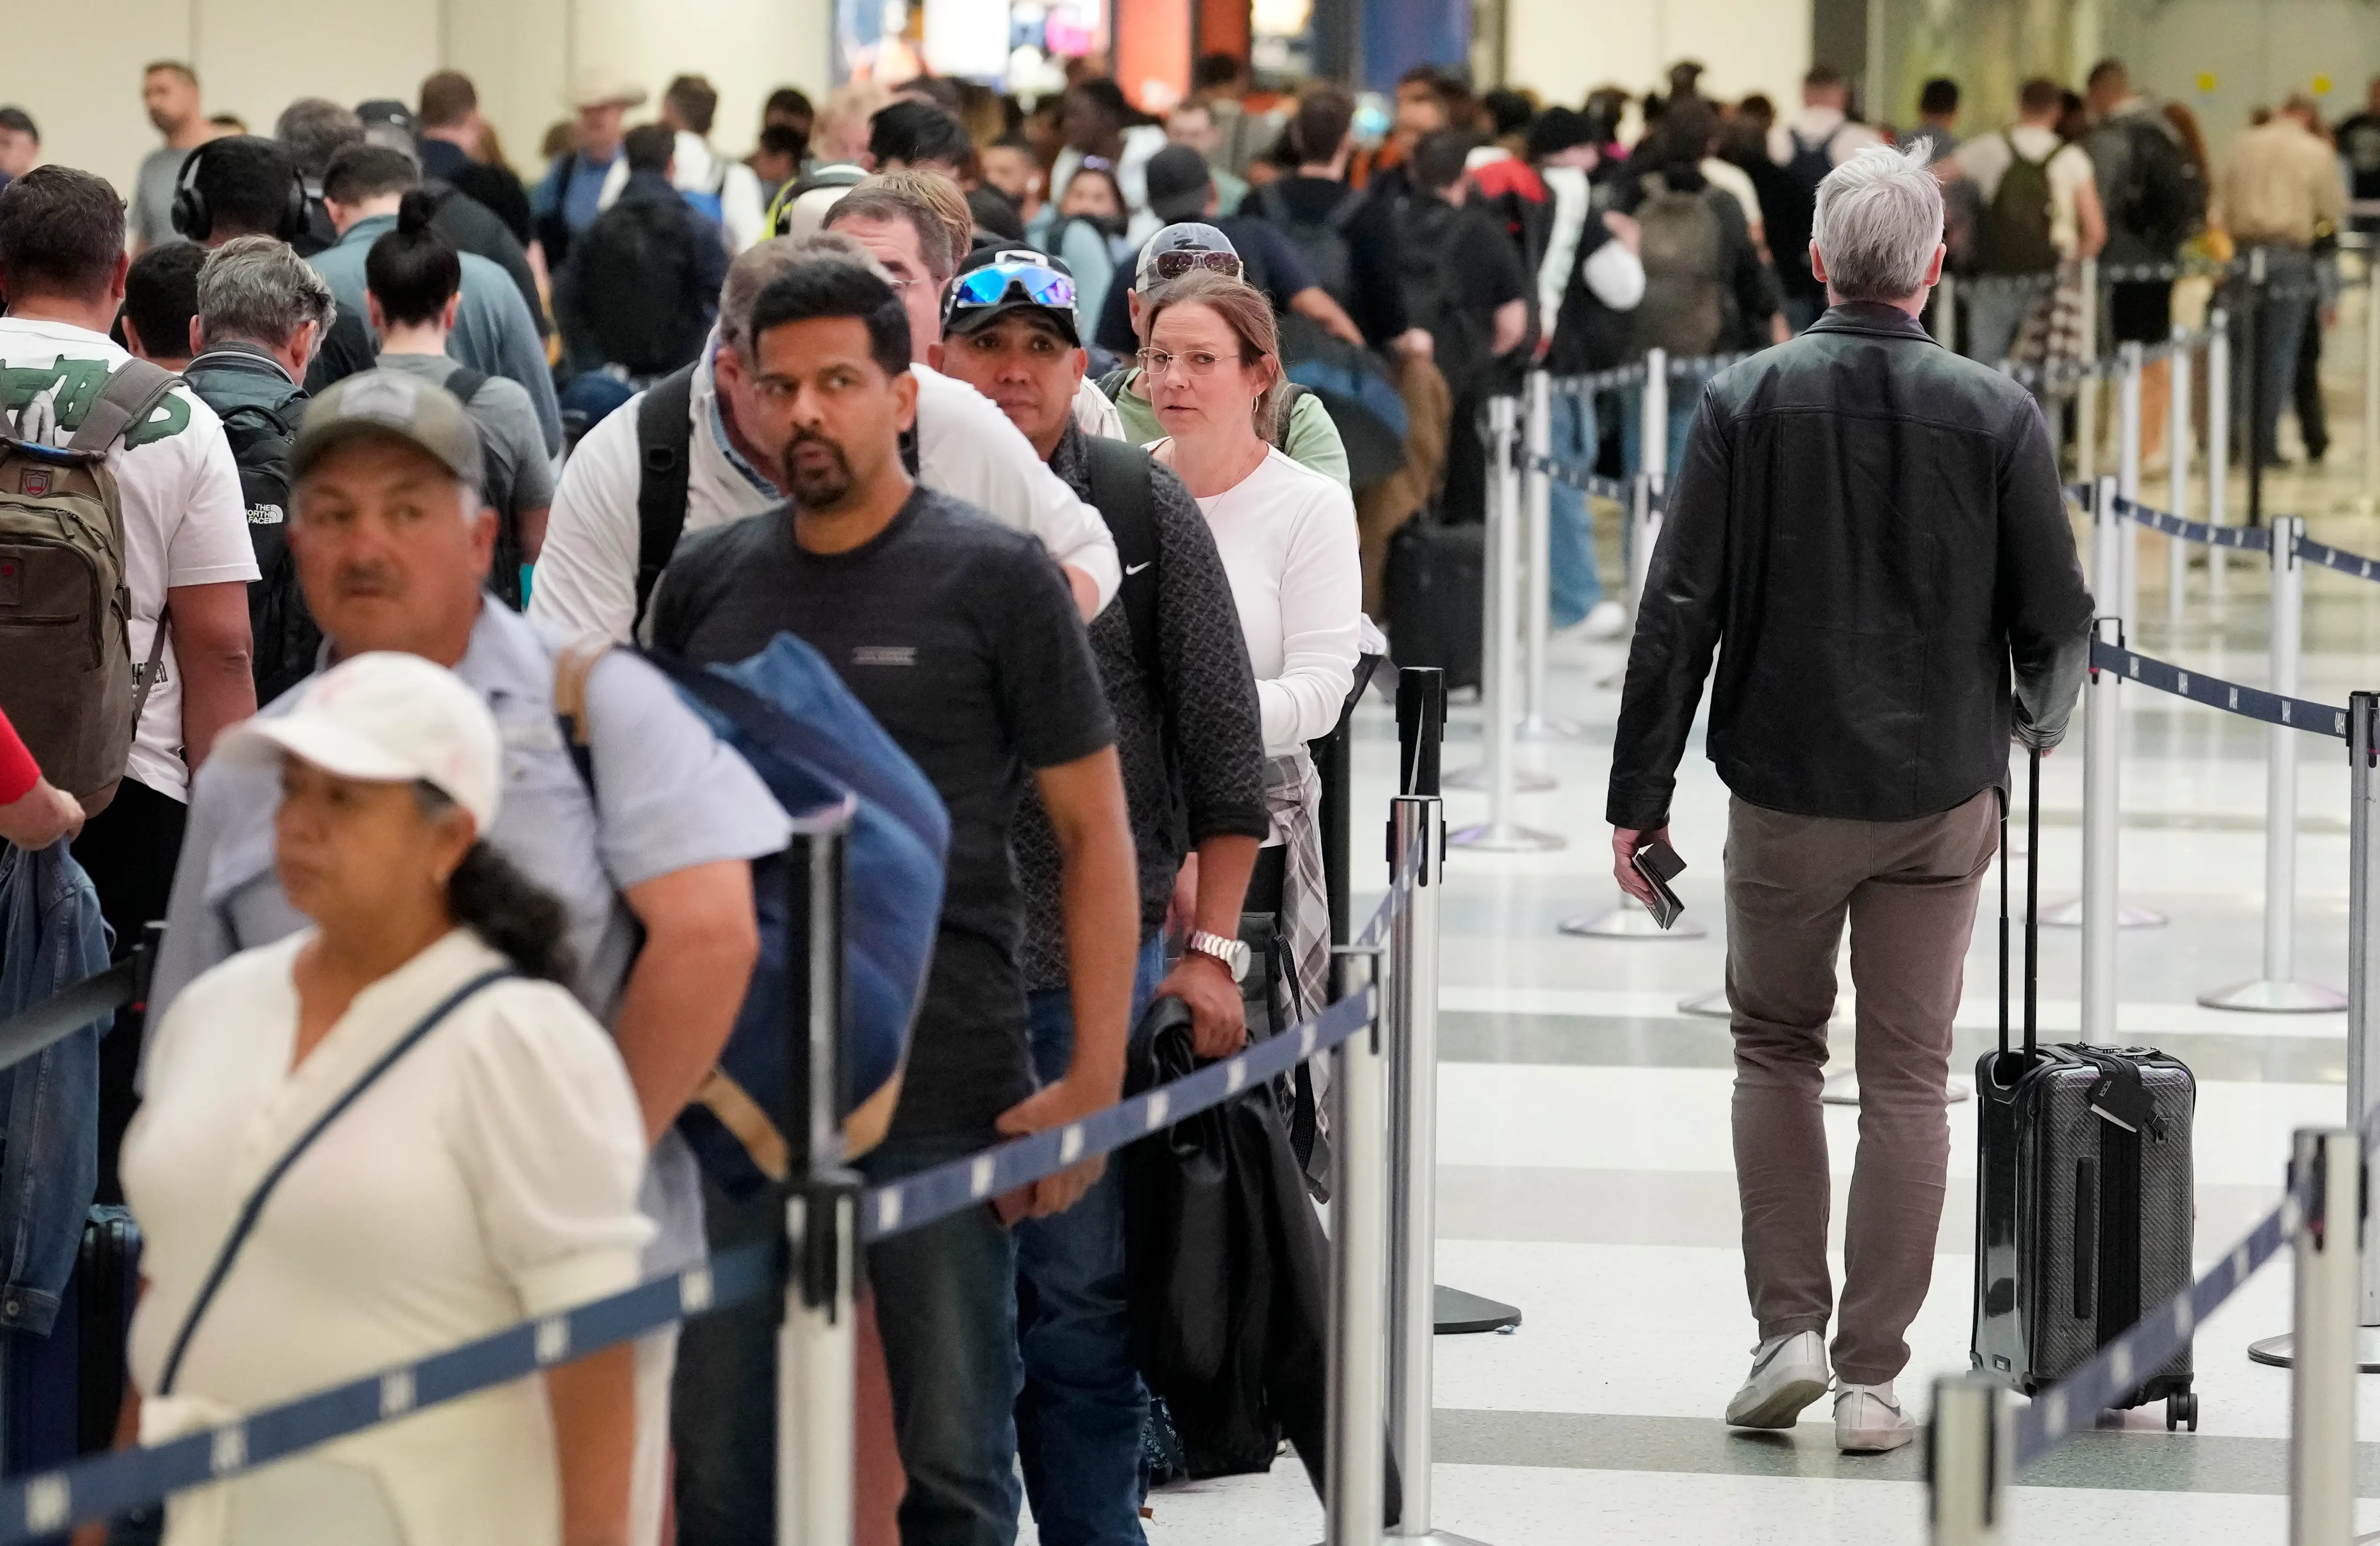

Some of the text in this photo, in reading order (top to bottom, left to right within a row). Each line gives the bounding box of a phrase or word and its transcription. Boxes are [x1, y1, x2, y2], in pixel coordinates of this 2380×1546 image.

[246, 509, 270, 518] ORTH
[2281, 700, 2291, 724] IAH
[2335, 711, 2346, 735] IAH
[2098, 1080, 2112, 1098] TUMI
